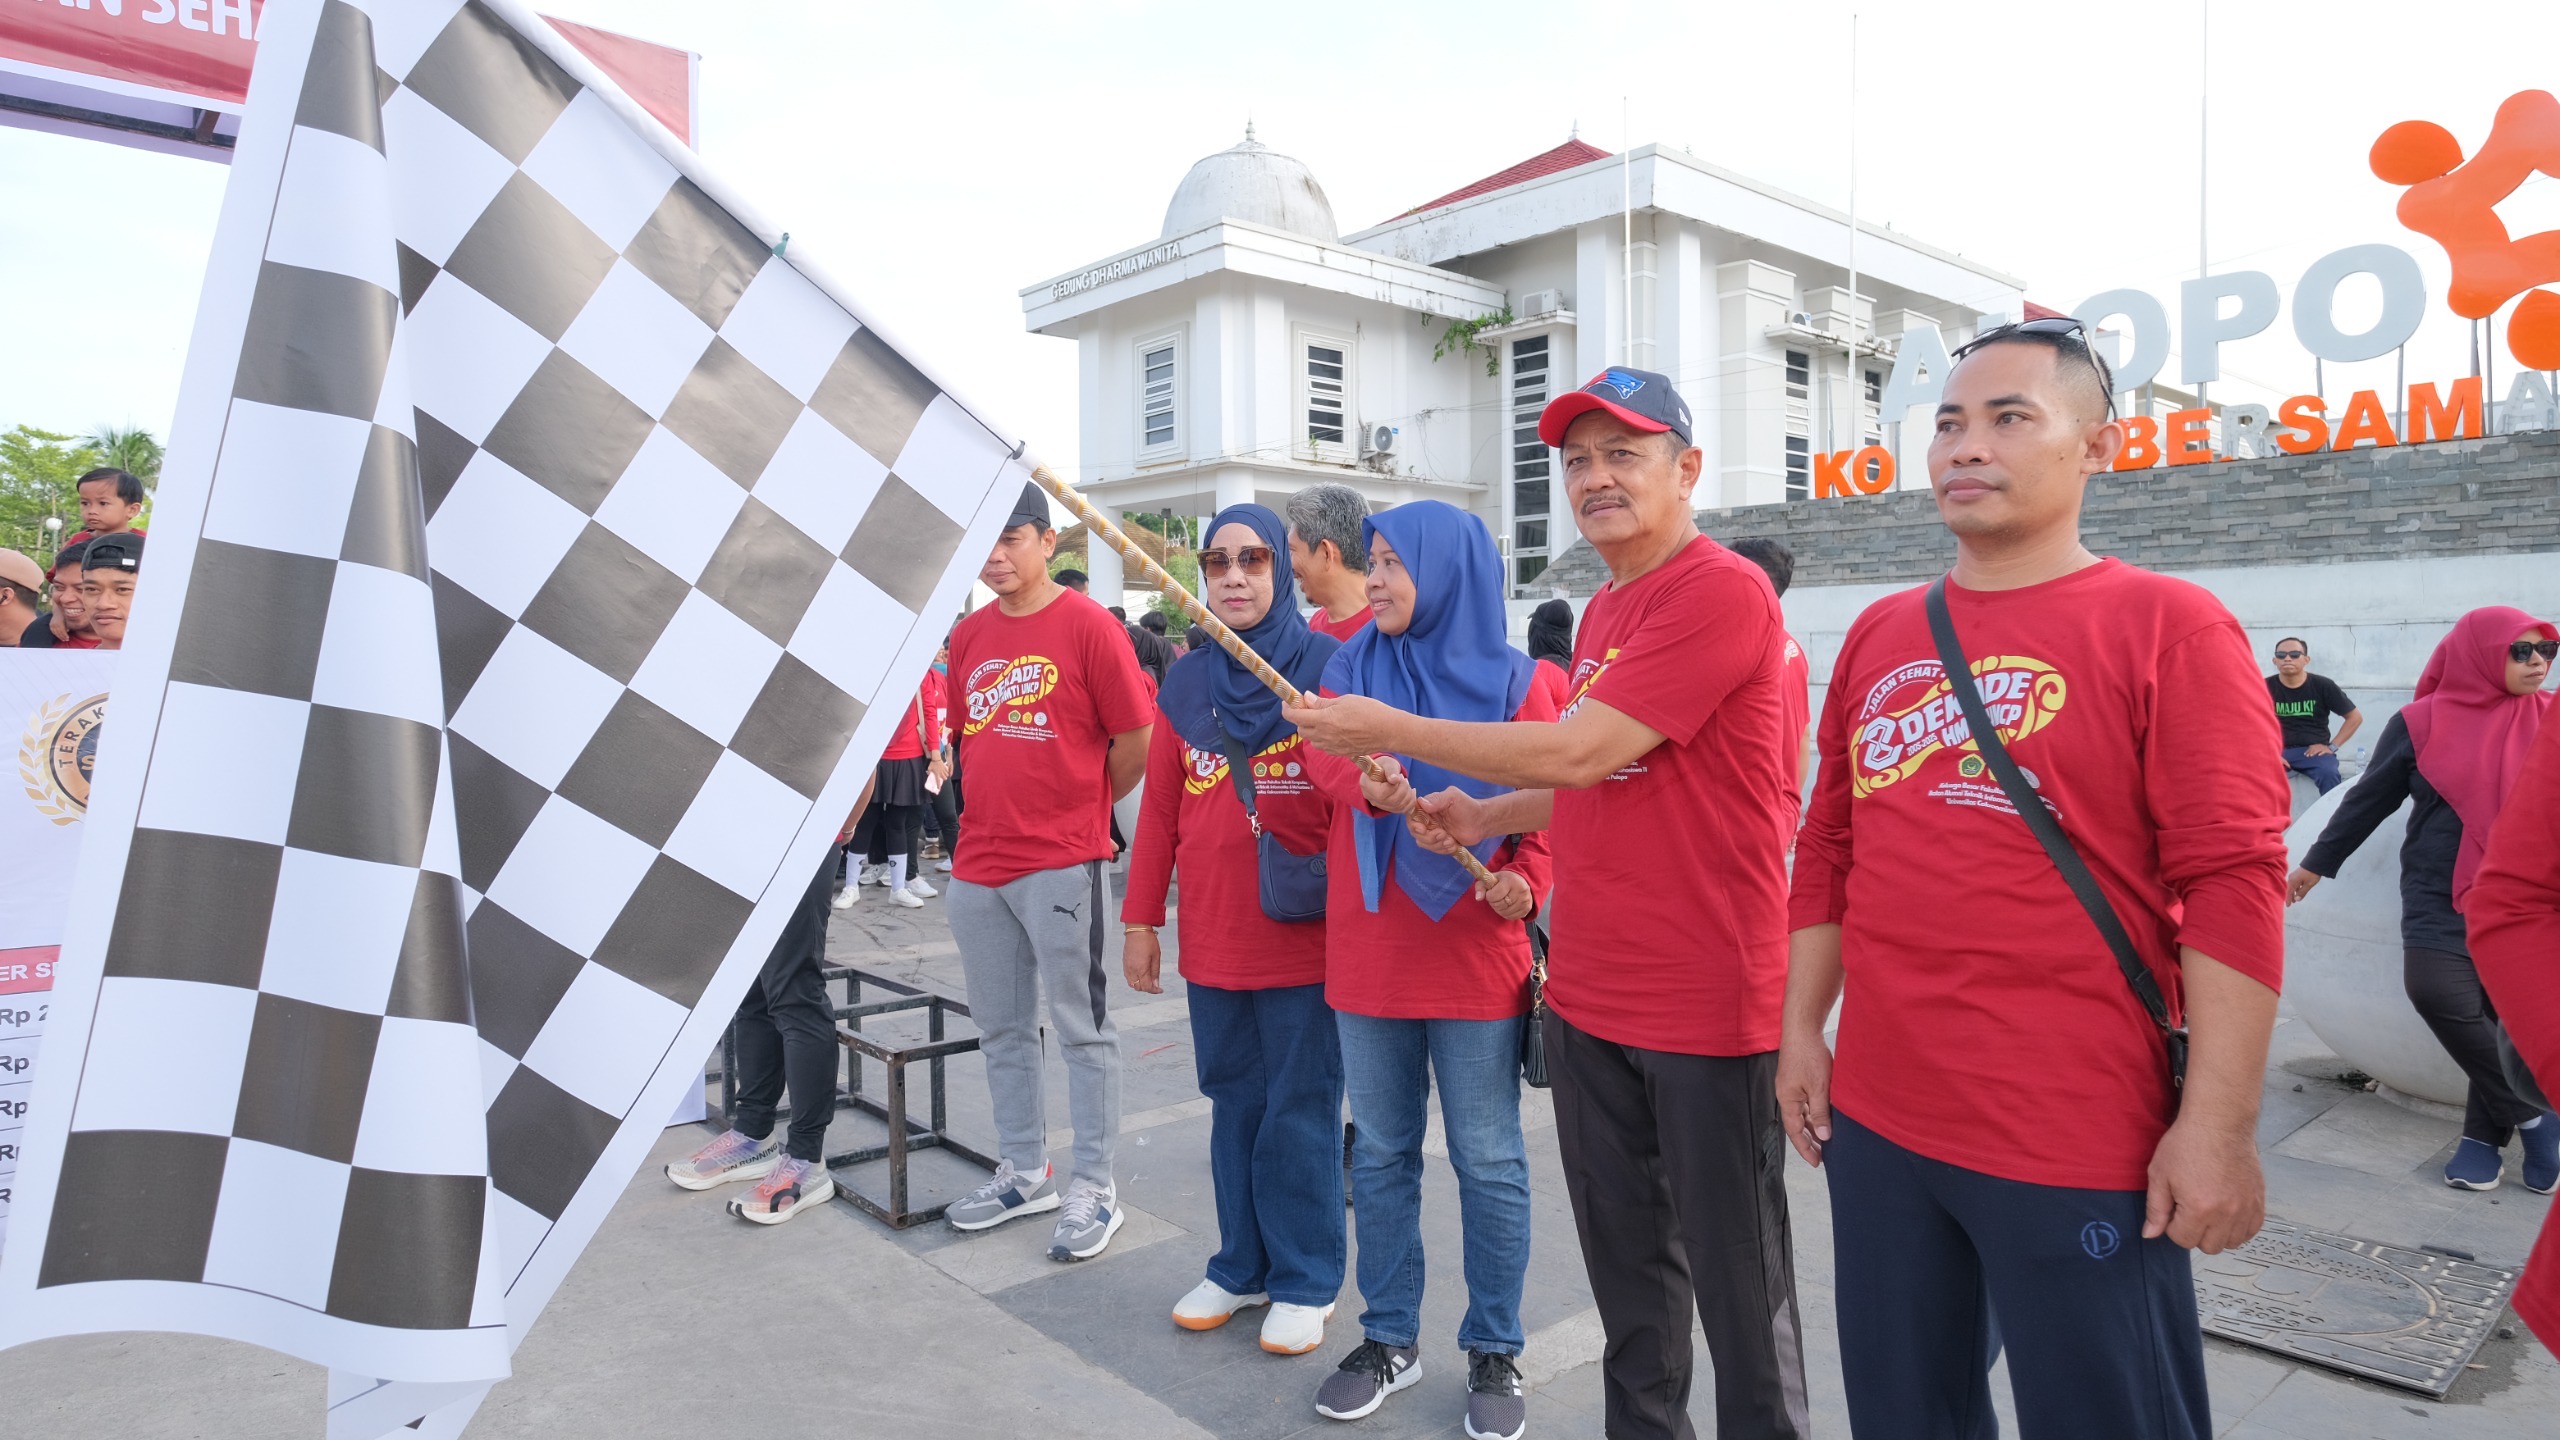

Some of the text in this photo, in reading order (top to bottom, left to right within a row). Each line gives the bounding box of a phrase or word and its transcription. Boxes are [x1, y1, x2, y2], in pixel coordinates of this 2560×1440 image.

[1050, 271, 1092, 299] GEDUNG
[1878, 243, 2427, 424] AOPO
[1869, 666, 1941, 714] JALAN SEHAT
[2276, 701, 2301, 714] MAJU
[739, 1142, 778, 1168] RUNNING
